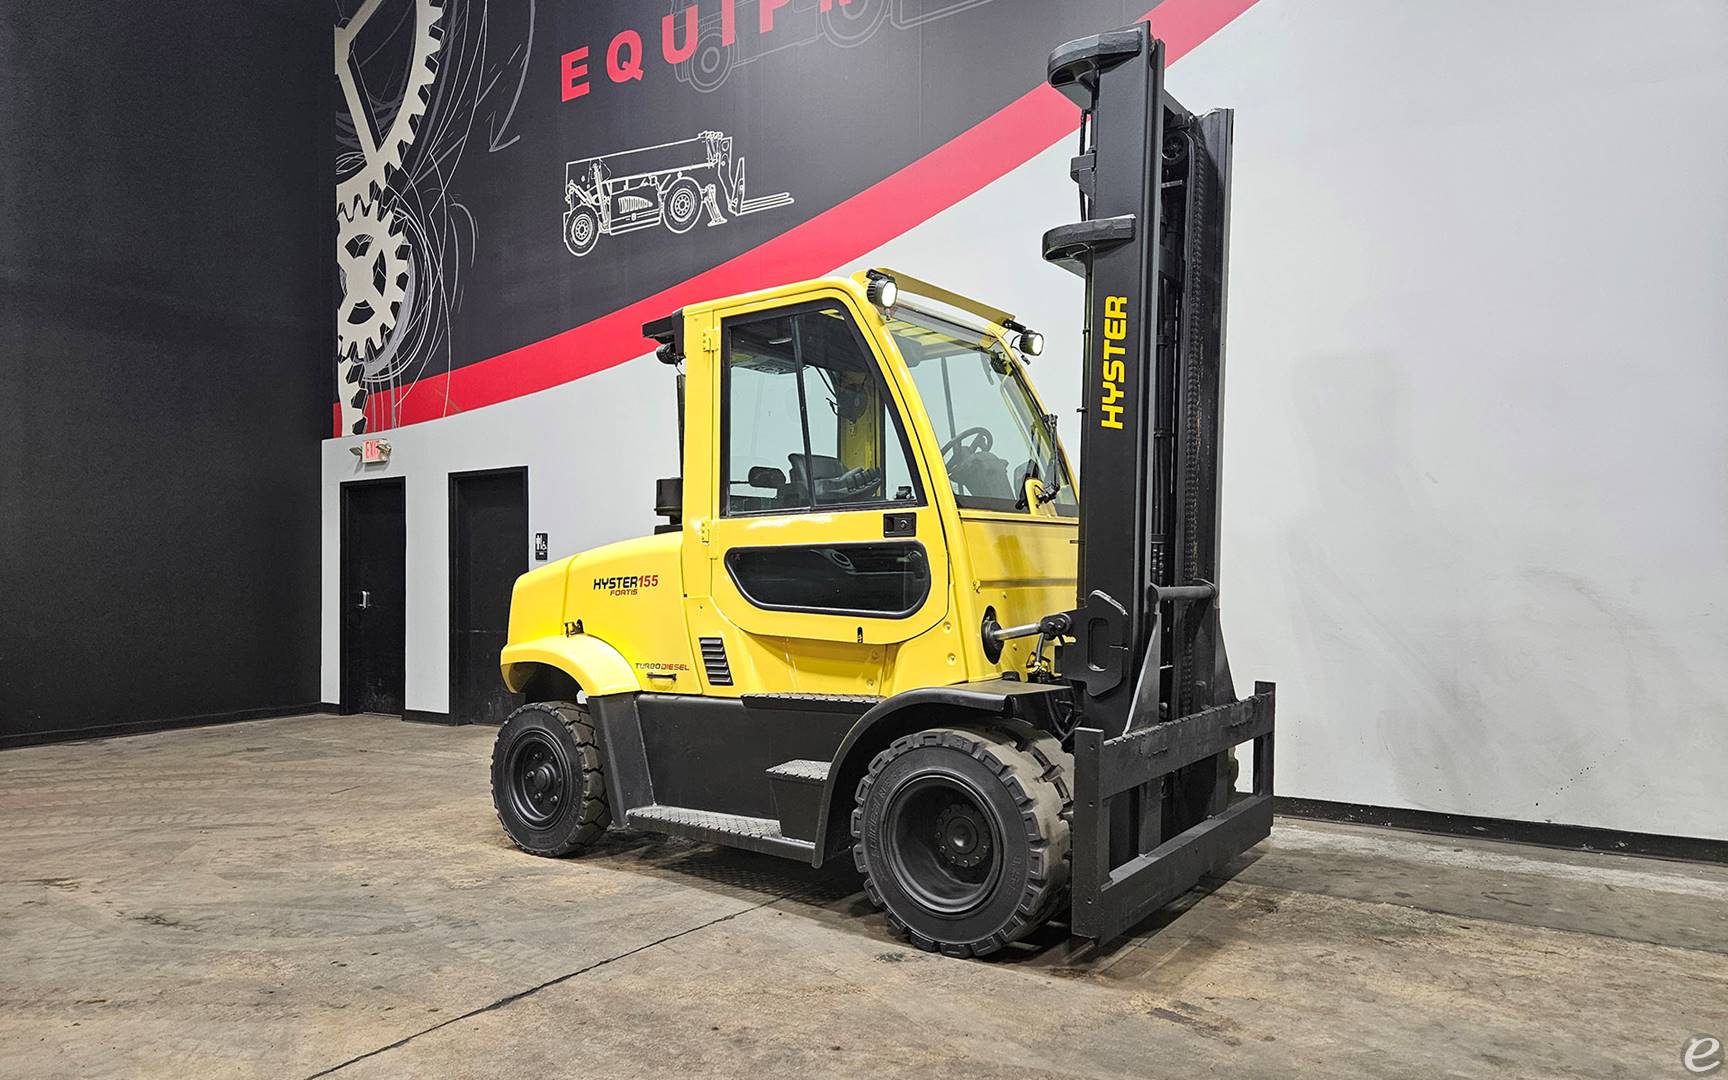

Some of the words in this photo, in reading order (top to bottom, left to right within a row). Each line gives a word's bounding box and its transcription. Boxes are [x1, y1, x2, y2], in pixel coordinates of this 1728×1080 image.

[561, 0, 852, 102] EQUIP
[1101, 295, 1127, 430] HYSTER
[609, 588, 638, 596] FORTIS
